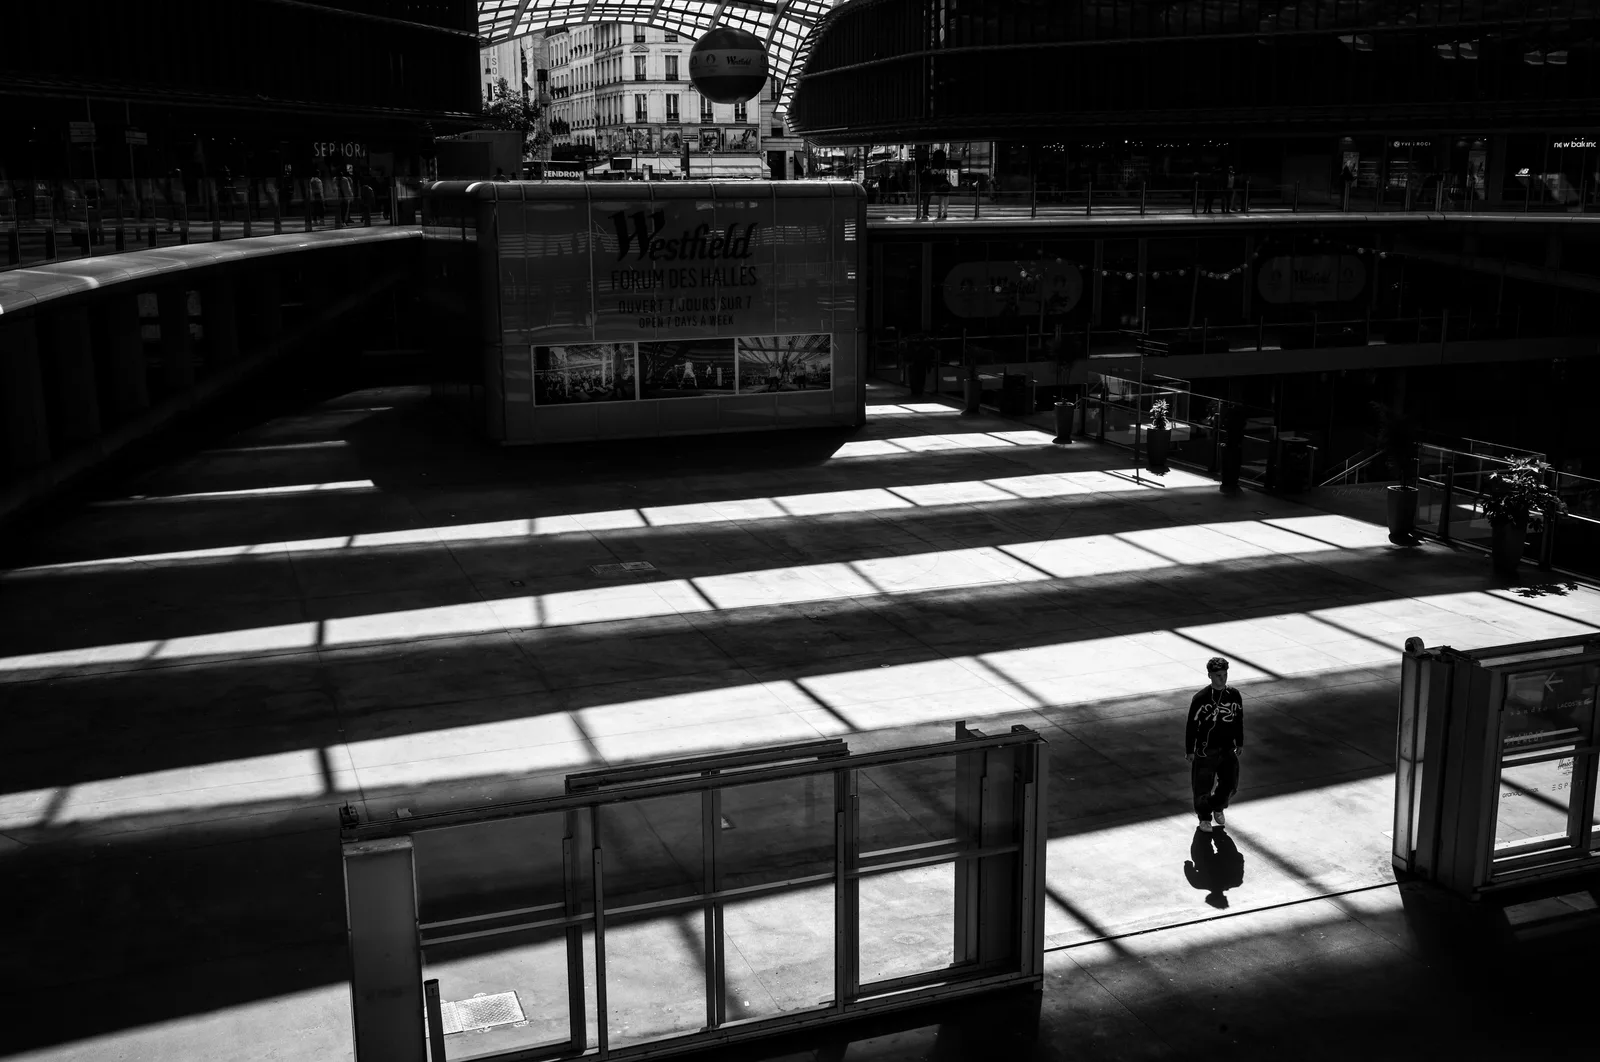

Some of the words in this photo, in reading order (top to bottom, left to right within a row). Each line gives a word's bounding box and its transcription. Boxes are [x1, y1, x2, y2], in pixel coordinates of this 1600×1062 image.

[608, 209, 758, 261] Westfield
[611, 268, 664, 289] FORUM
[669, 267, 697, 288] DES
[701, 266, 757, 287] HALLES
[619, 299, 663, 313] OUVERT
[669, 299, 674, 312] 7
[678, 296, 715, 312] JOURS
[720, 296, 742, 310] SUR
[747, 296, 751, 309] 7
[639, 317, 663, 328] OPEN
[667, 317, 671, 327] 7
[675, 316, 697, 327] DAYS
[701, 316, 706, 325] A
[710, 315, 734, 325] WEEK
